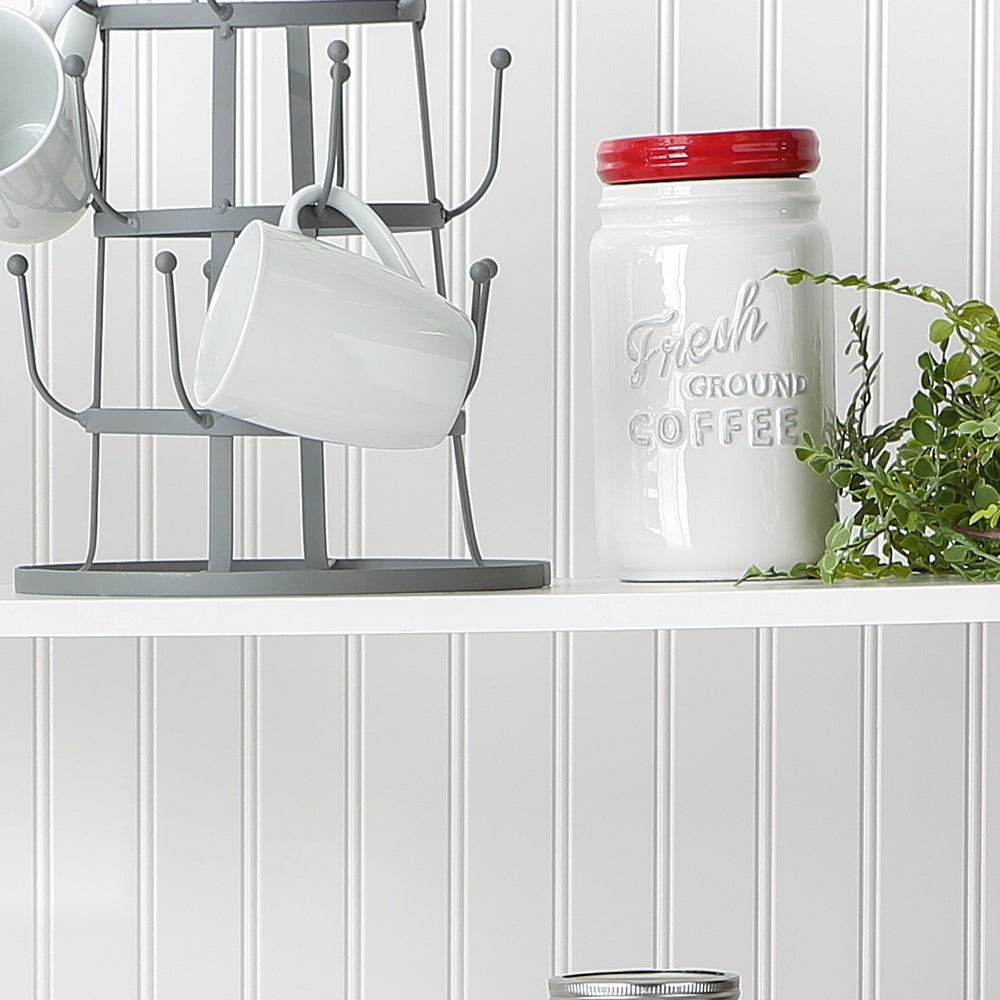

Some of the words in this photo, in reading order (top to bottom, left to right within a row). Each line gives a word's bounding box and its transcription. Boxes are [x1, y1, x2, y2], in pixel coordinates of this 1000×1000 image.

[625, 280, 768, 389] Fresh
[686, 373, 808, 398] GROUND
[628, 407, 799, 447] COFFEE
